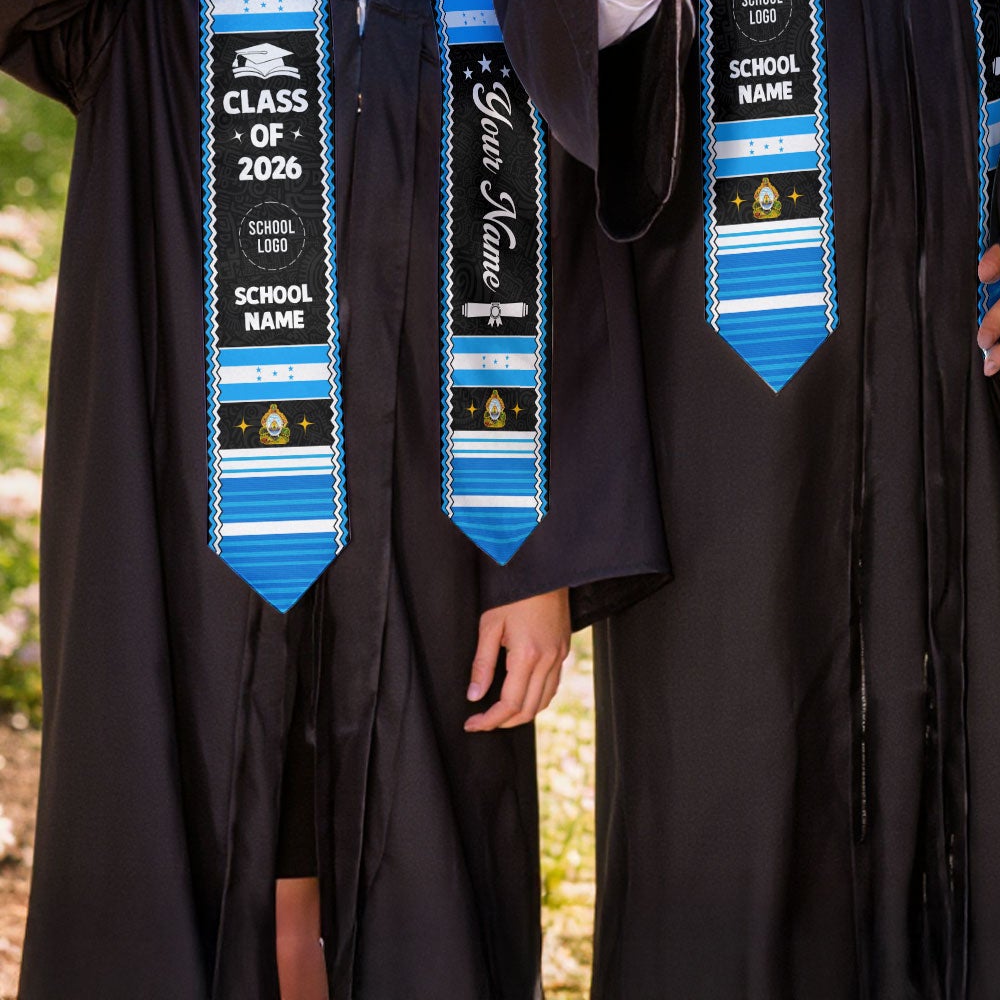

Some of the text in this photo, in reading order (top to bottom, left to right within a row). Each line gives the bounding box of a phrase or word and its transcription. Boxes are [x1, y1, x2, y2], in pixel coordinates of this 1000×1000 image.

[749, 7, 777, 25] LOGO
[729, 53, 801, 79] SCHOOL
[222, 88, 309, 115] CLASS
[738, 80, 793, 105] NAME
[249, 122, 284, 149] OF
[237, 155, 303, 182] 2026
[472, 81, 517, 293] Your Name
[248, 219, 296, 236] SCHOOL
[257, 237, 288, 254] LOGO
[234, 283, 314, 306] SCHOOL
[243, 309, 305, 332] NAME
